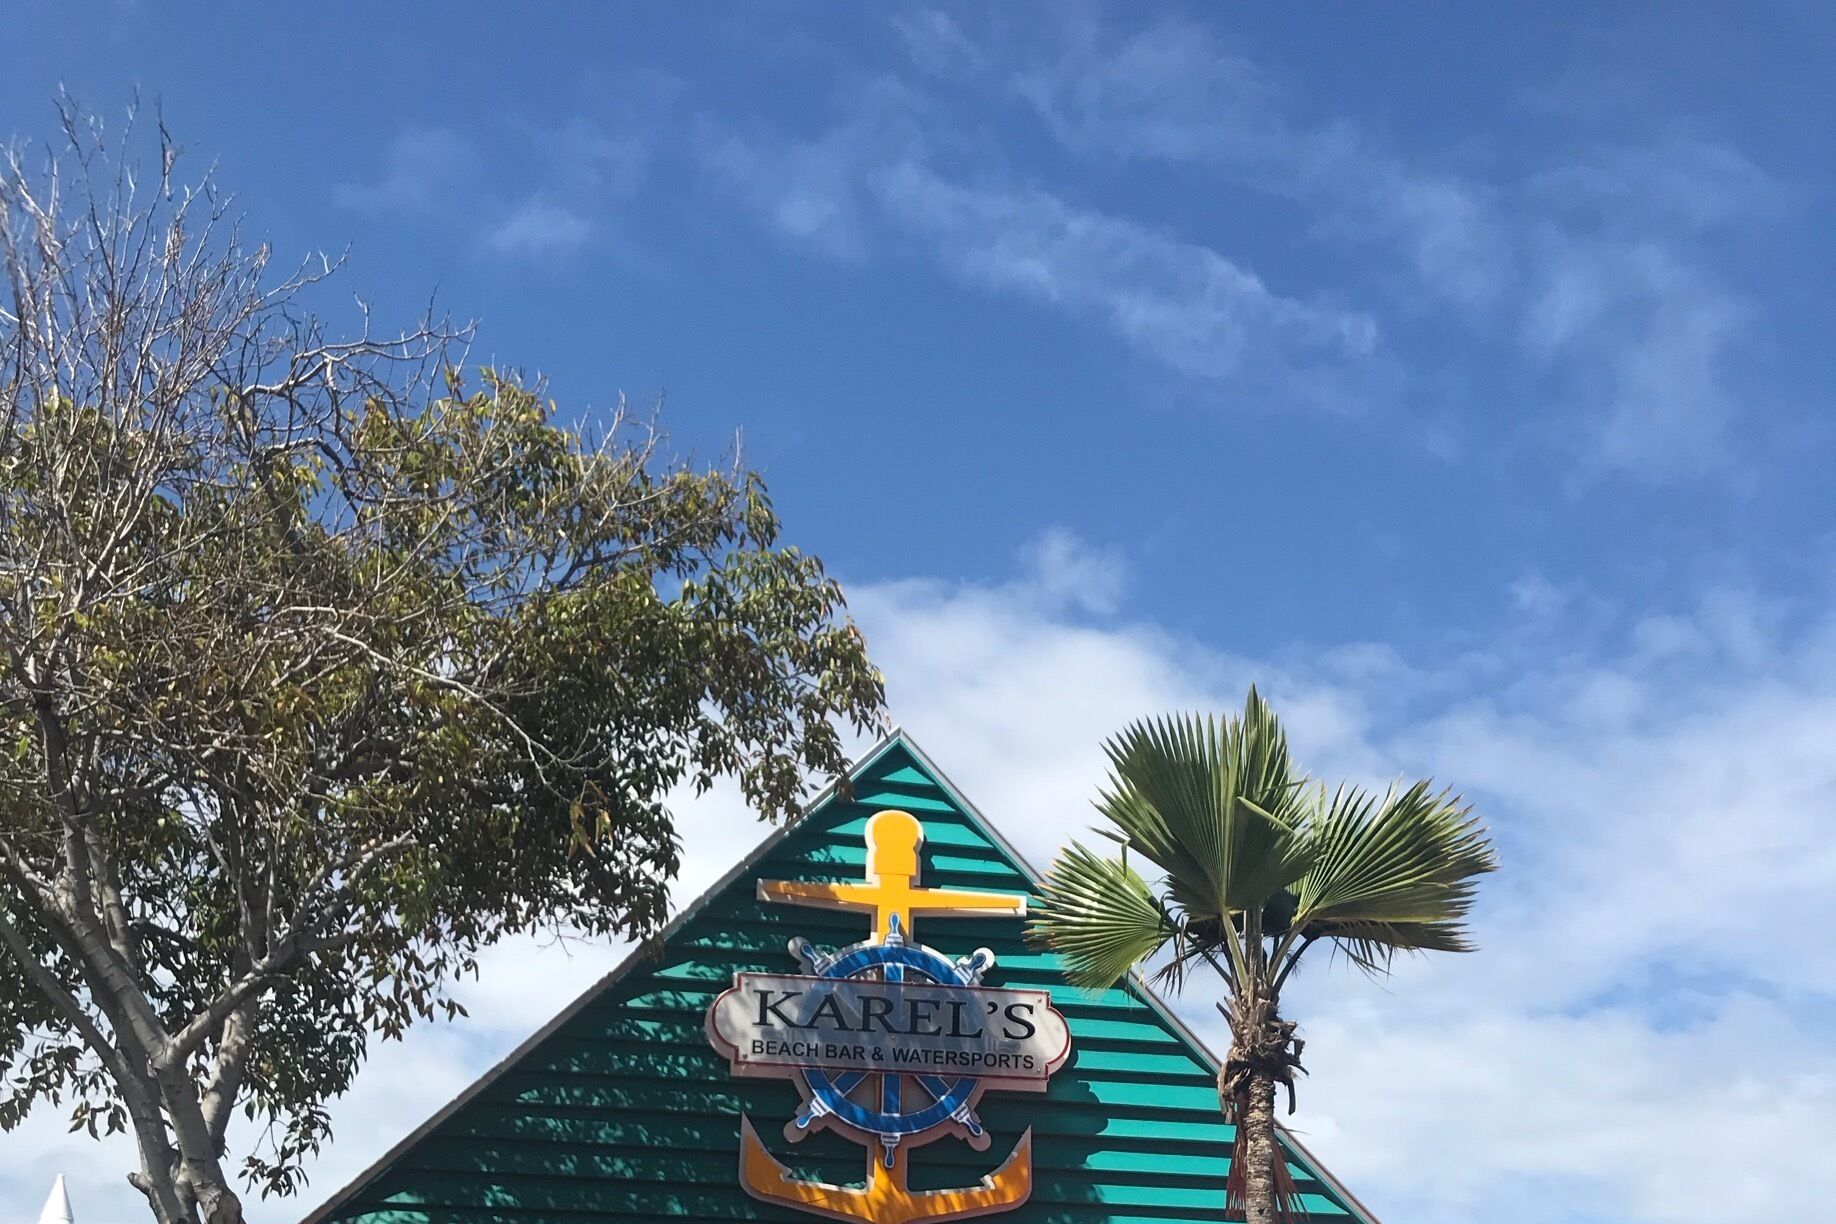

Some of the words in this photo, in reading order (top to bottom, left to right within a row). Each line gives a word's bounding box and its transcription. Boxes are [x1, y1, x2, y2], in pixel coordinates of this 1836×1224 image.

[752, 989, 1036, 1040] KAREL'S
[752, 1040, 819, 1058] BEACH
[825, 1044, 866, 1060] BAR
[871, 1046, 884, 1061] &
[892, 1048, 1034, 1069] WATERSPORTS
